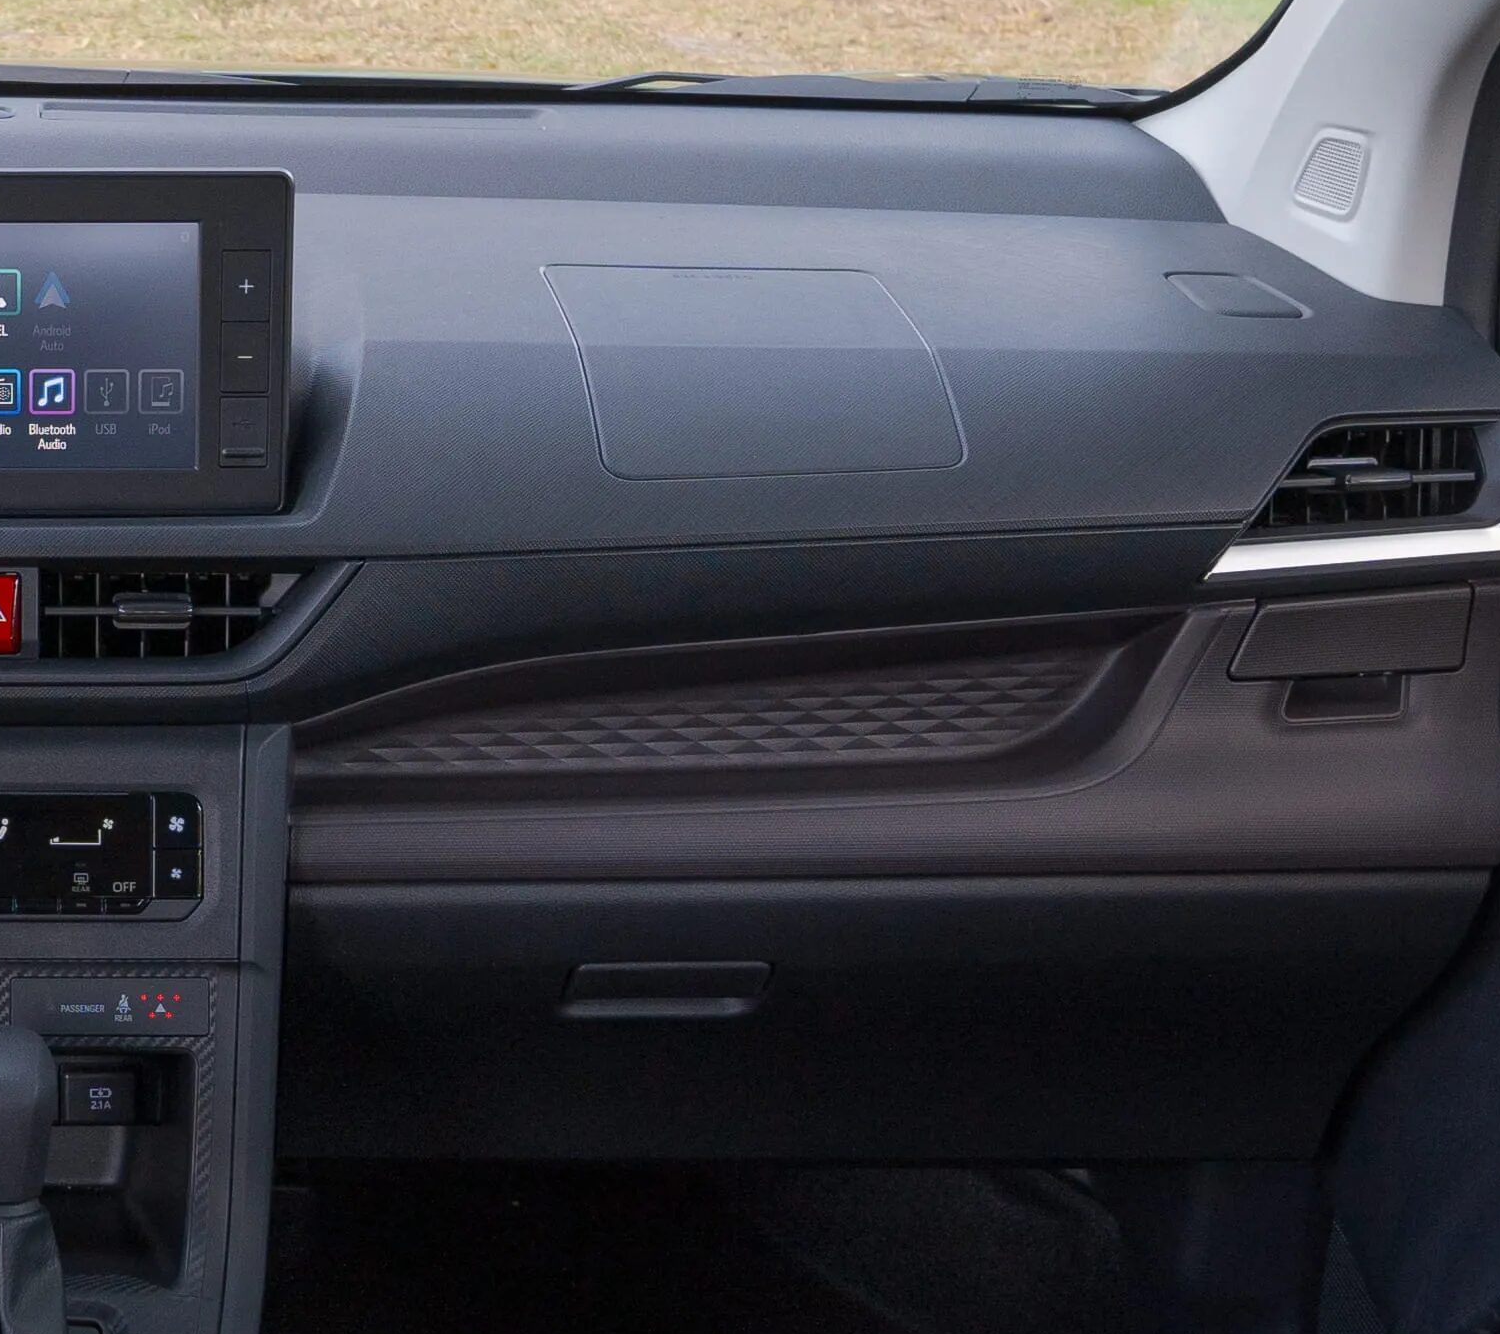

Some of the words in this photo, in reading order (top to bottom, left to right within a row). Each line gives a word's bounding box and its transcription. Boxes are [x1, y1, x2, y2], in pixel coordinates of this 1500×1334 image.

[33, 324, 71, 337] Android
[40, 340, 64, 351] Auto
[28, 423, 76, 436] Bluetooth
[95, 423, 117, 436] USB
[148, 423, 171, 436] iPod
[37, 438, 67, 451] Audio
[112, 881, 137, 893] OFF
[60, 1004, 105, 1014] PASSENGER
[114, 1014, 133, 1022] REAR
[90, 1100, 111, 1110] 2.1A
